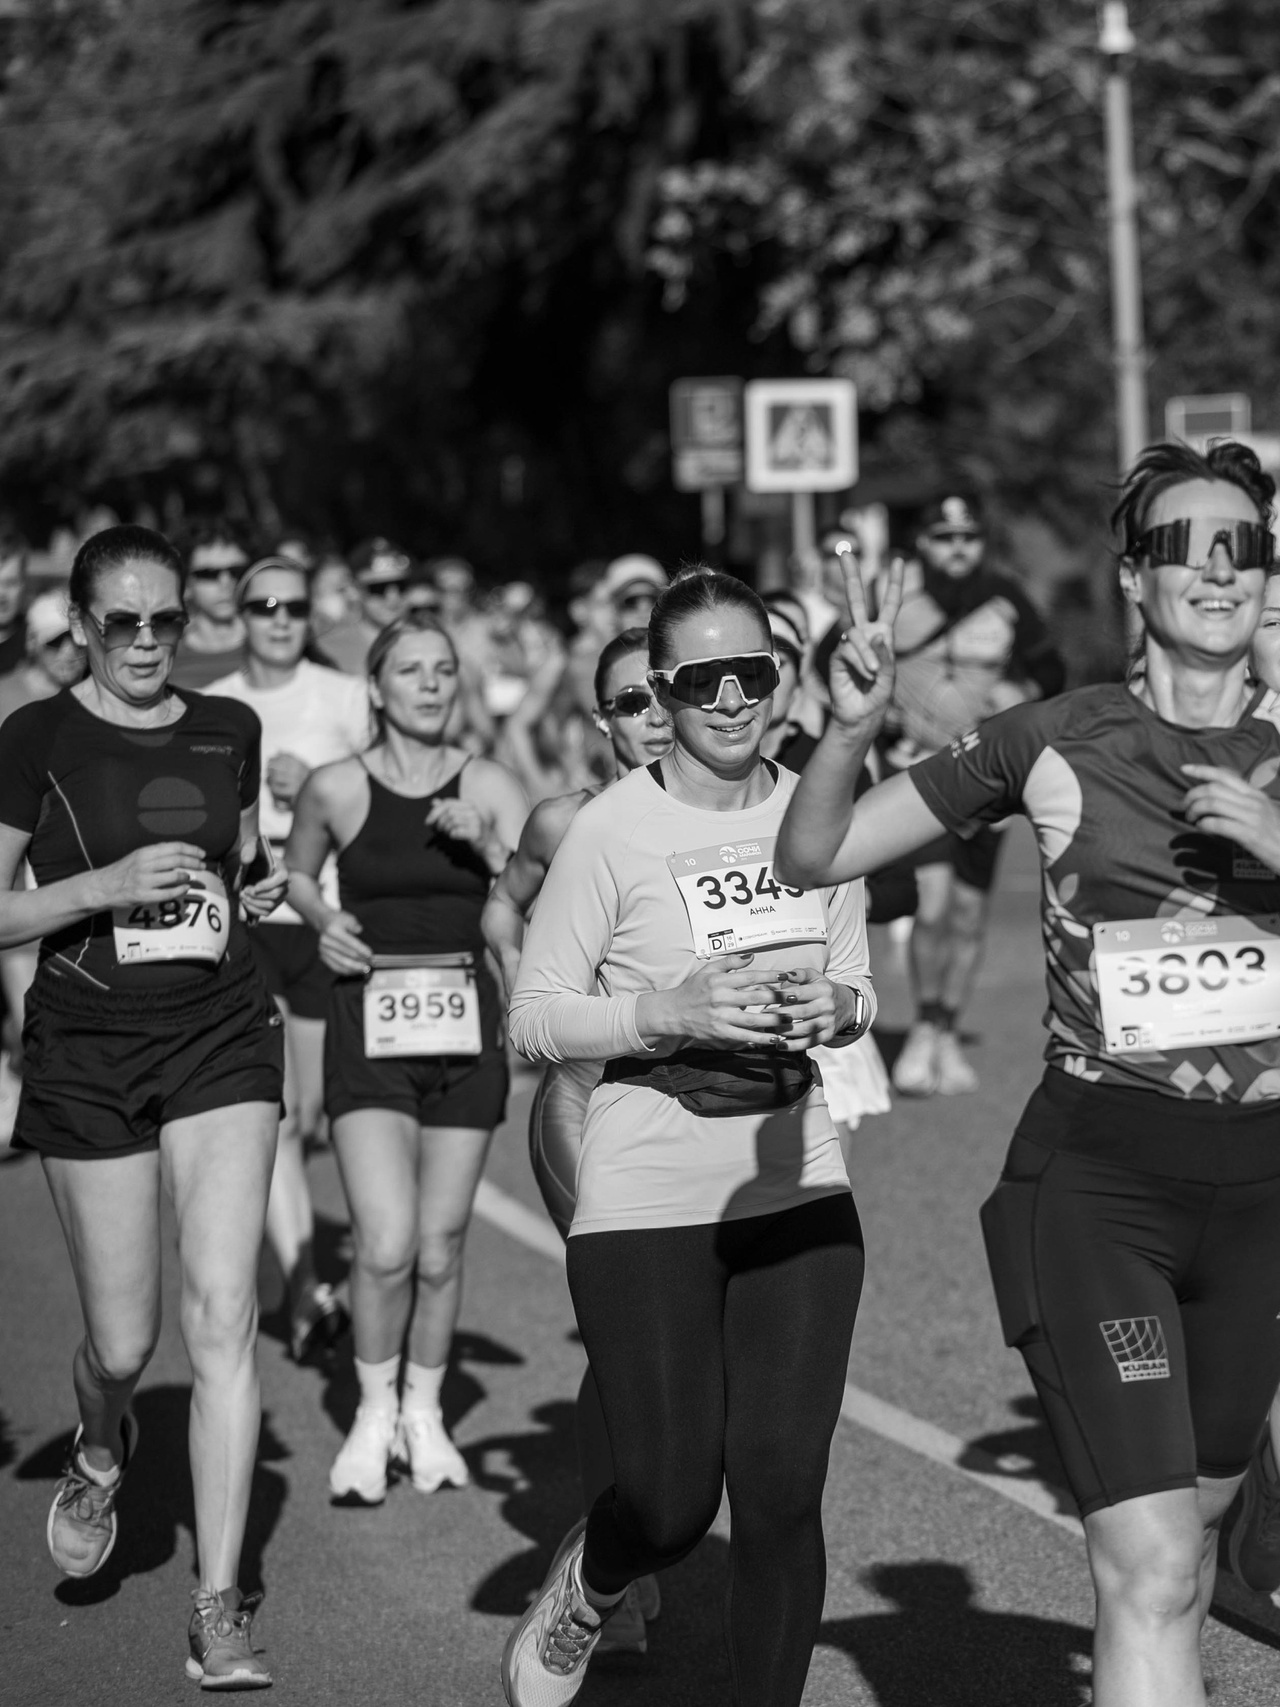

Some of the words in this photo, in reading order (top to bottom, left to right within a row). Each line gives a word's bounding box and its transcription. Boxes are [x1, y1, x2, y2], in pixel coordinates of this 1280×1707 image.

[684, 857, 697, 867] 10
[128, 897, 222, 933] 4876
[749, 905, 776, 916] АННА
[1115, 930, 1131, 942] 10
[711, 938, 723, 950] D
[378, 992, 465, 1022] 3959
[1125, 1032, 1137, 1046] D
